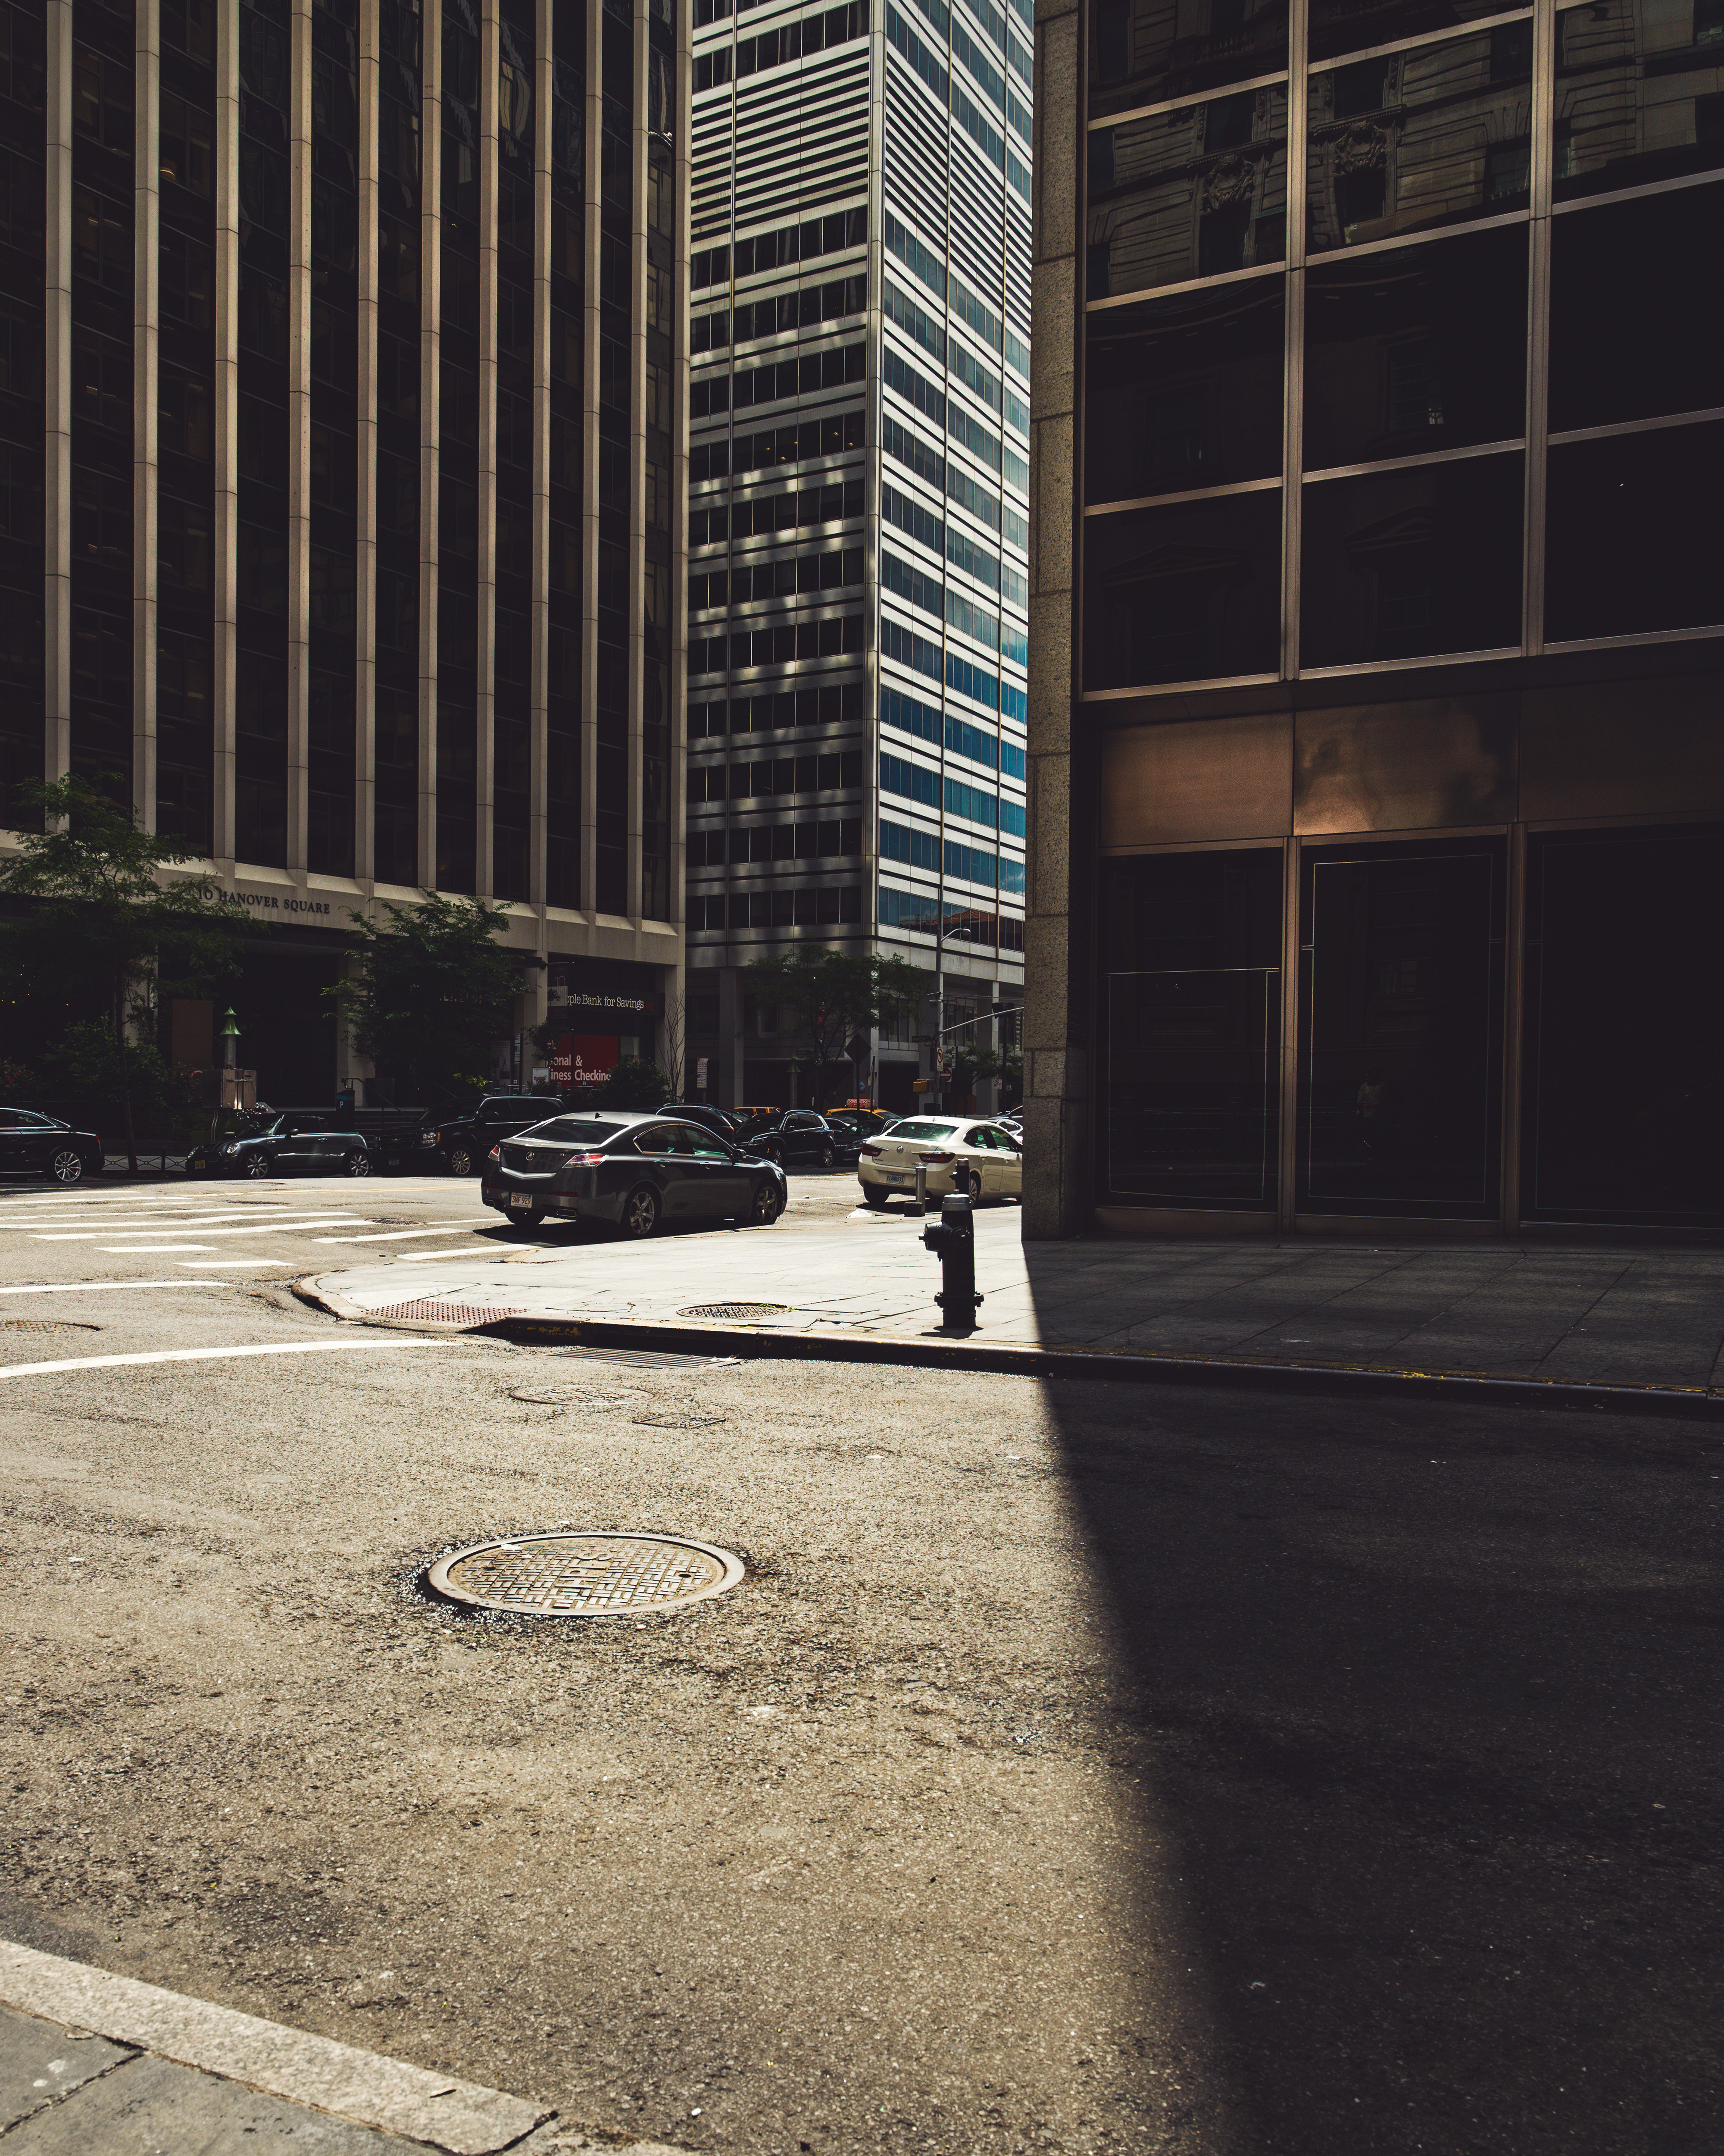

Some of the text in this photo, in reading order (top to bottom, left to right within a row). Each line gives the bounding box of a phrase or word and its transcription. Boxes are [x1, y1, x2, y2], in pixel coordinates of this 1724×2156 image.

[219, 891, 278, 907] HANOVER
[284, 898, 330, 914] SQUARE
[555, 976, 565, 986] 10
[567, 993, 644, 1011] ple Bank for Savings
[575, 1055, 582, 1067] &
[551, 1068, 572, 1080] iness
[555, 1552, 614, 1589] HPFS
